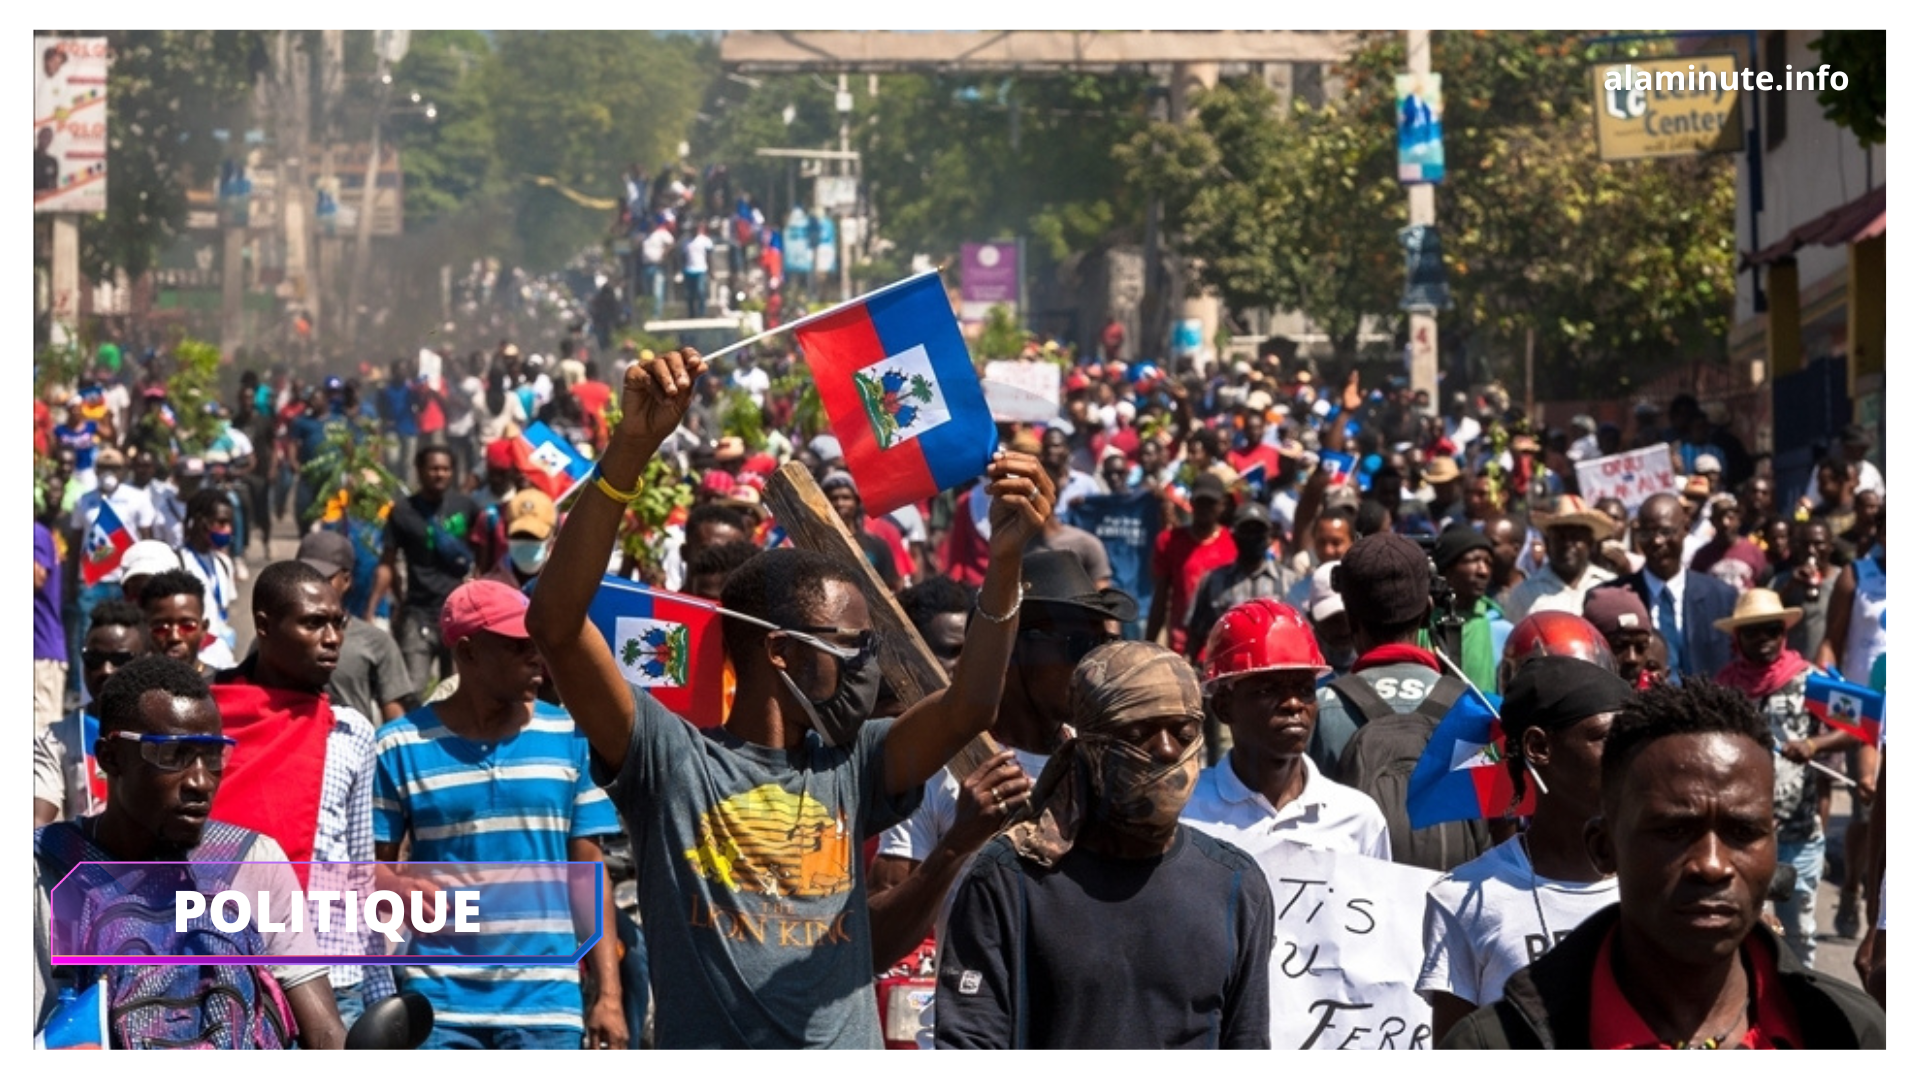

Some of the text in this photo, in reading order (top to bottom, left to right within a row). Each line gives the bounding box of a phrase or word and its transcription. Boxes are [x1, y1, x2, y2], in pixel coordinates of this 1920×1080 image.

[1644, 109, 1726, 137] Center
[690, 894, 766, 945] LION
[758, 901, 795, 915] THE
